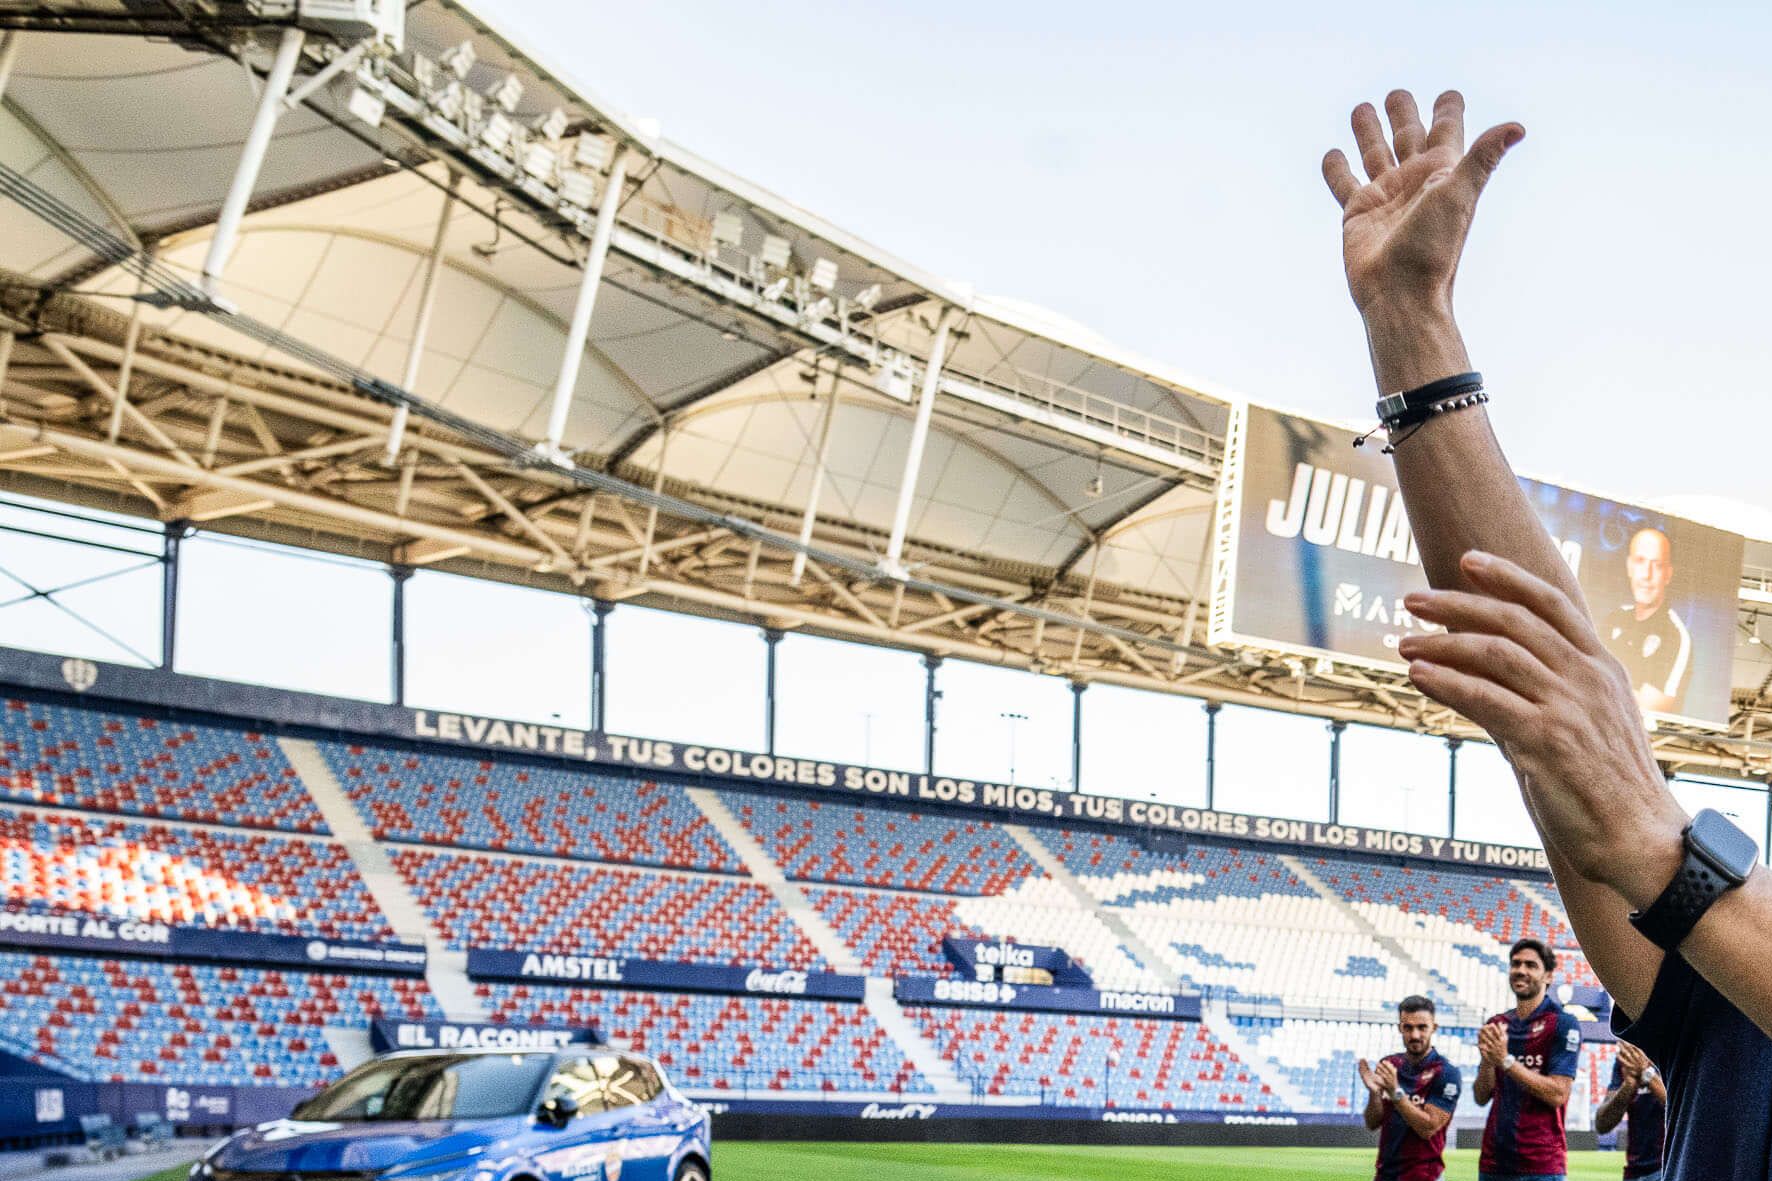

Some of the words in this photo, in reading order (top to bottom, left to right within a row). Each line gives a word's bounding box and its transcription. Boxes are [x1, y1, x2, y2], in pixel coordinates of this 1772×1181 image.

[1265, 462, 1422, 568] JULIA
[415, 711, 596, 761] LEVANTE,
[607, 735, 675, 766] TUS
[684, 745, 836, 787] COLORES
[844, 767, 910, 795] SON
[919, 776, 976, 803] LOS
[1069, 794, 1122, 819] TUS
[1129, 803, 1249, 836] COLORES
[1255, 818, 1306, 842] SON
[1313, 825, 1359, 847] LOS
[1428, 838, 1444, 857] Y
[1450, 841, 1479, 861] TU
[1485, 845, 1550, 868] NOMB
[81, 919, 116, 940] AL
[118, 922, 170, 944] COR
[974, 942, 1034, 967] teika
[521, 954, 623, 981] AMSTEL
[1101, 991, 1175, 1012] macron
[398, 1025, 434, 1046] EL
[439, 1026, 574, 1049] RACONET
